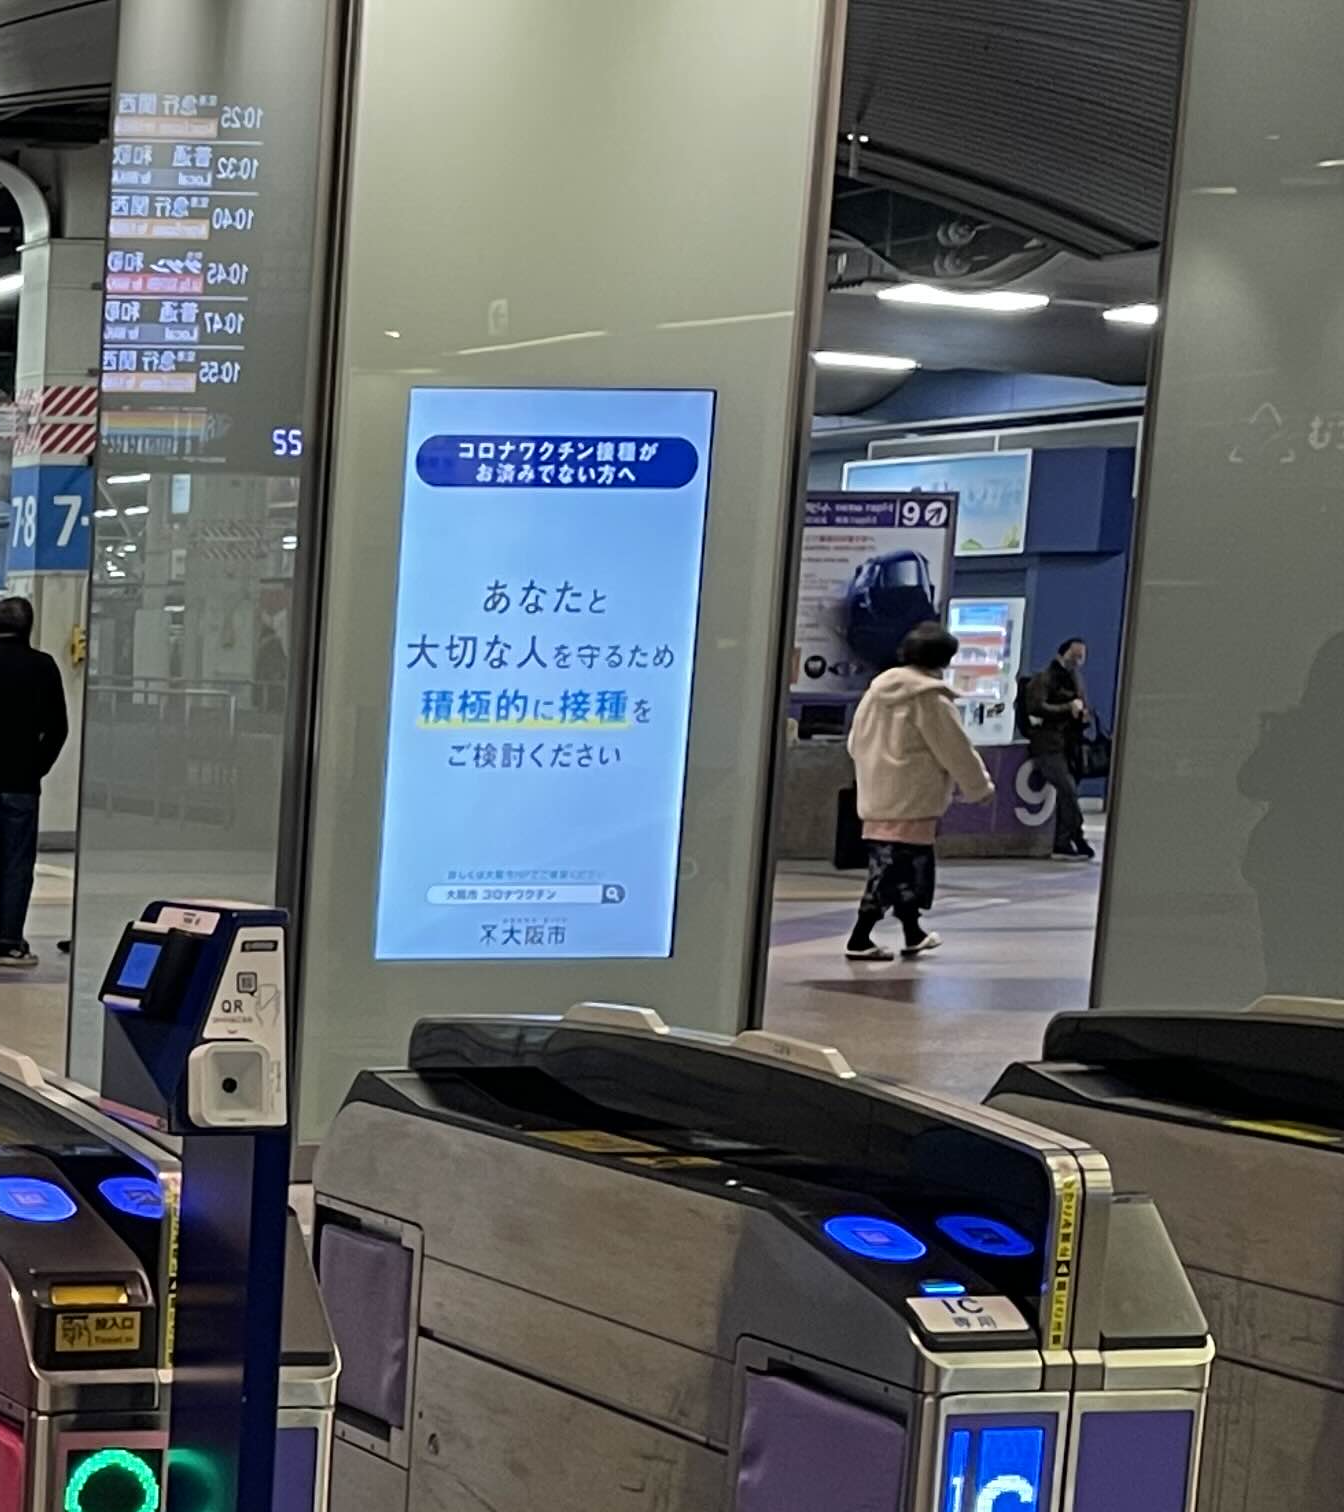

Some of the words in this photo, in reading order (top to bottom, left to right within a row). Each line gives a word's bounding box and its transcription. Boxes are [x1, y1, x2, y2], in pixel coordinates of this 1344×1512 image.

[459, 440, 657, 463] コロナワクチン接種が
[476, 464, 636, 484] お済みでない方へ
[902, 501, 920, 526] 9
[483, 578, 606, 615] あなたと
[407, 634, 675, 670] 大切な人を守るため
[421, 689, 651, 725] 積極的に接種を
[449, 743, 621, 769] ご検討ください
[501, 926, 566, 946] 大阪市
[222, 1000, 243, 1014] QR
[942, 1299, 984, 1315] IC
